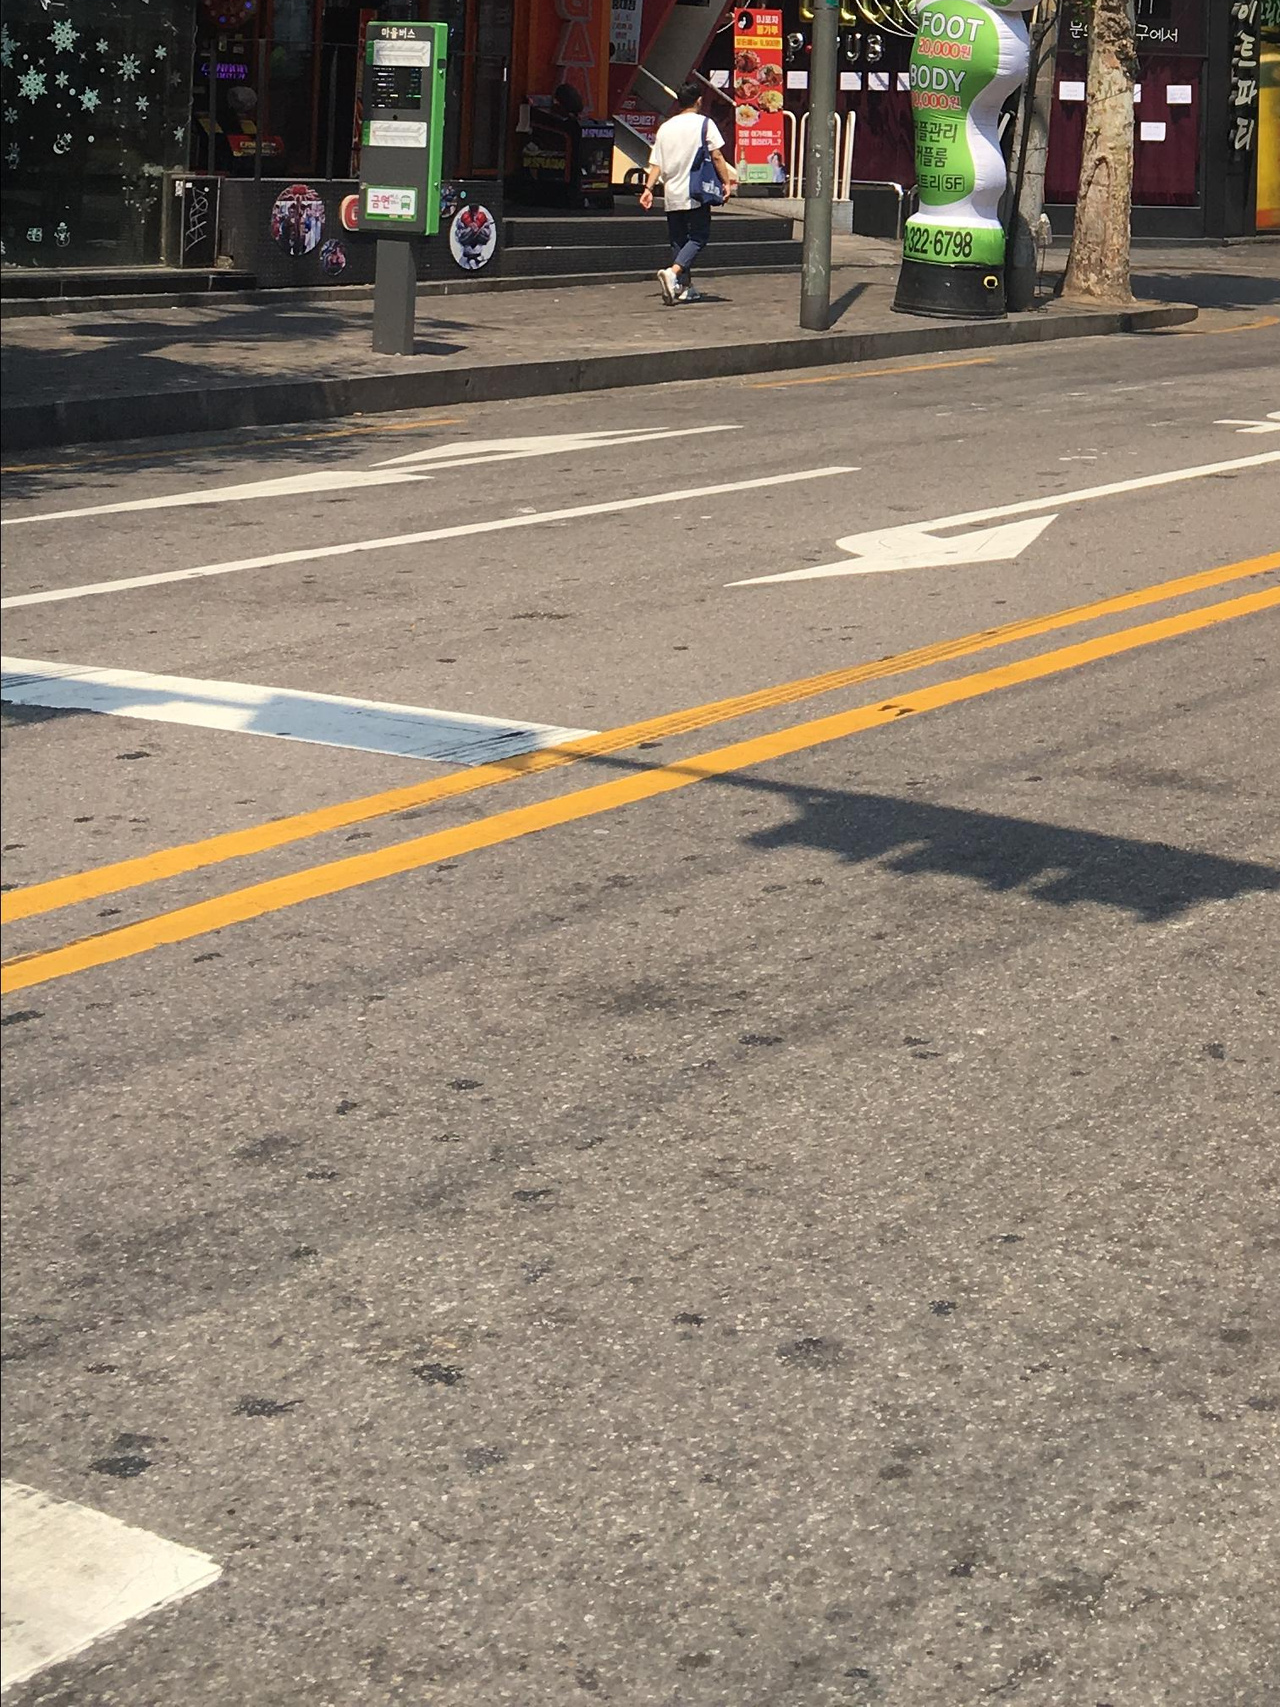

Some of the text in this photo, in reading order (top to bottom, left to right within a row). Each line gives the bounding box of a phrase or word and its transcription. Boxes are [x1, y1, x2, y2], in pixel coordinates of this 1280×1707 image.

[381, 27, 416, 39] 마을버스
[920, 11, 985, 42] FOOT
[917, 37, 973, 60] 20,000원
[910, 62, 966, 92] BODY
[915, 120, 959, 144] 플관리
[918, 175, 963, 191] 트리 5F
[371, 194, 391, 210] 금연
